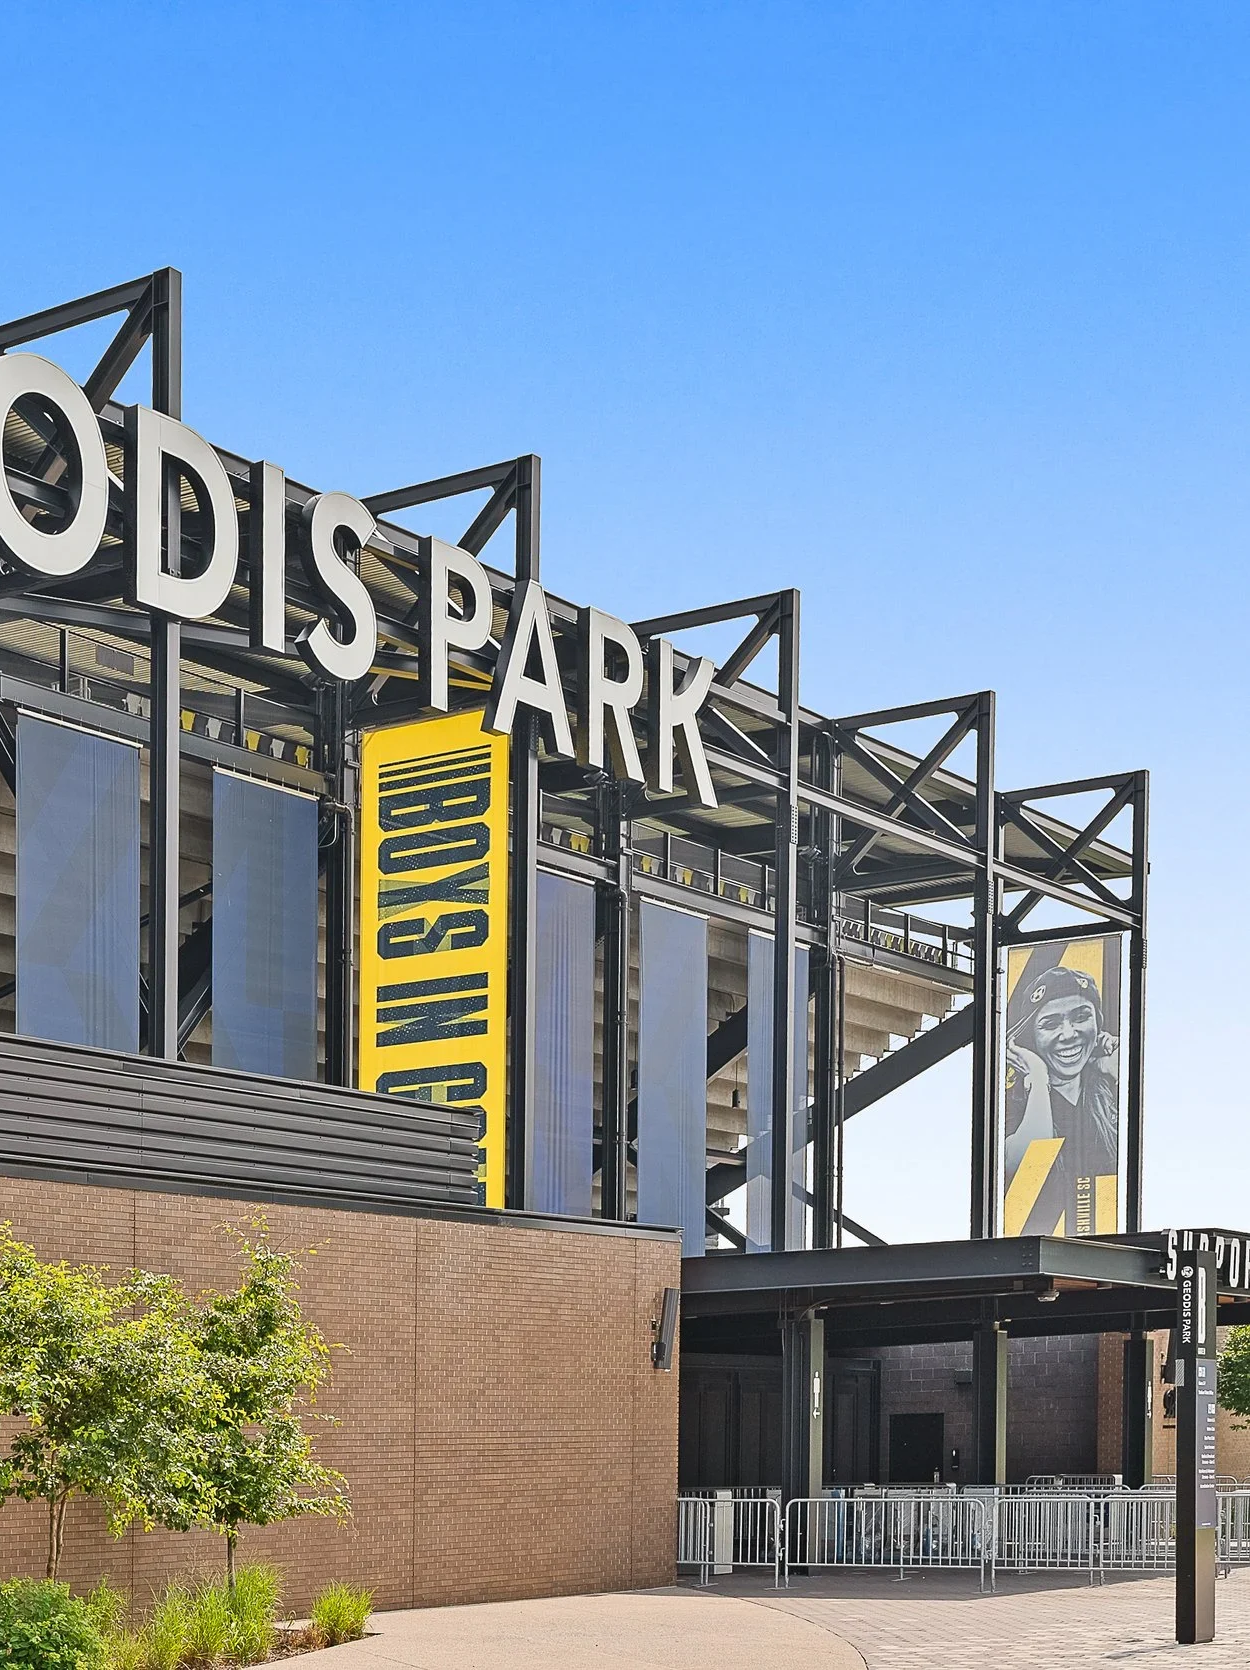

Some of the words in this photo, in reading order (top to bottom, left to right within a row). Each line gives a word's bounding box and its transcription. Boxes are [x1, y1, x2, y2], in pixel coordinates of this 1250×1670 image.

[423, 534, 719, 809] PARK
[378, 777, 491, 960] BOYS
[376, 972, 489, 1047] IN
[1077, 1177, 1091, 1190] SC
[1182, 1280, 1192, 1317] GEODIS
[1182, 1319, 1192, 1344] PARK
